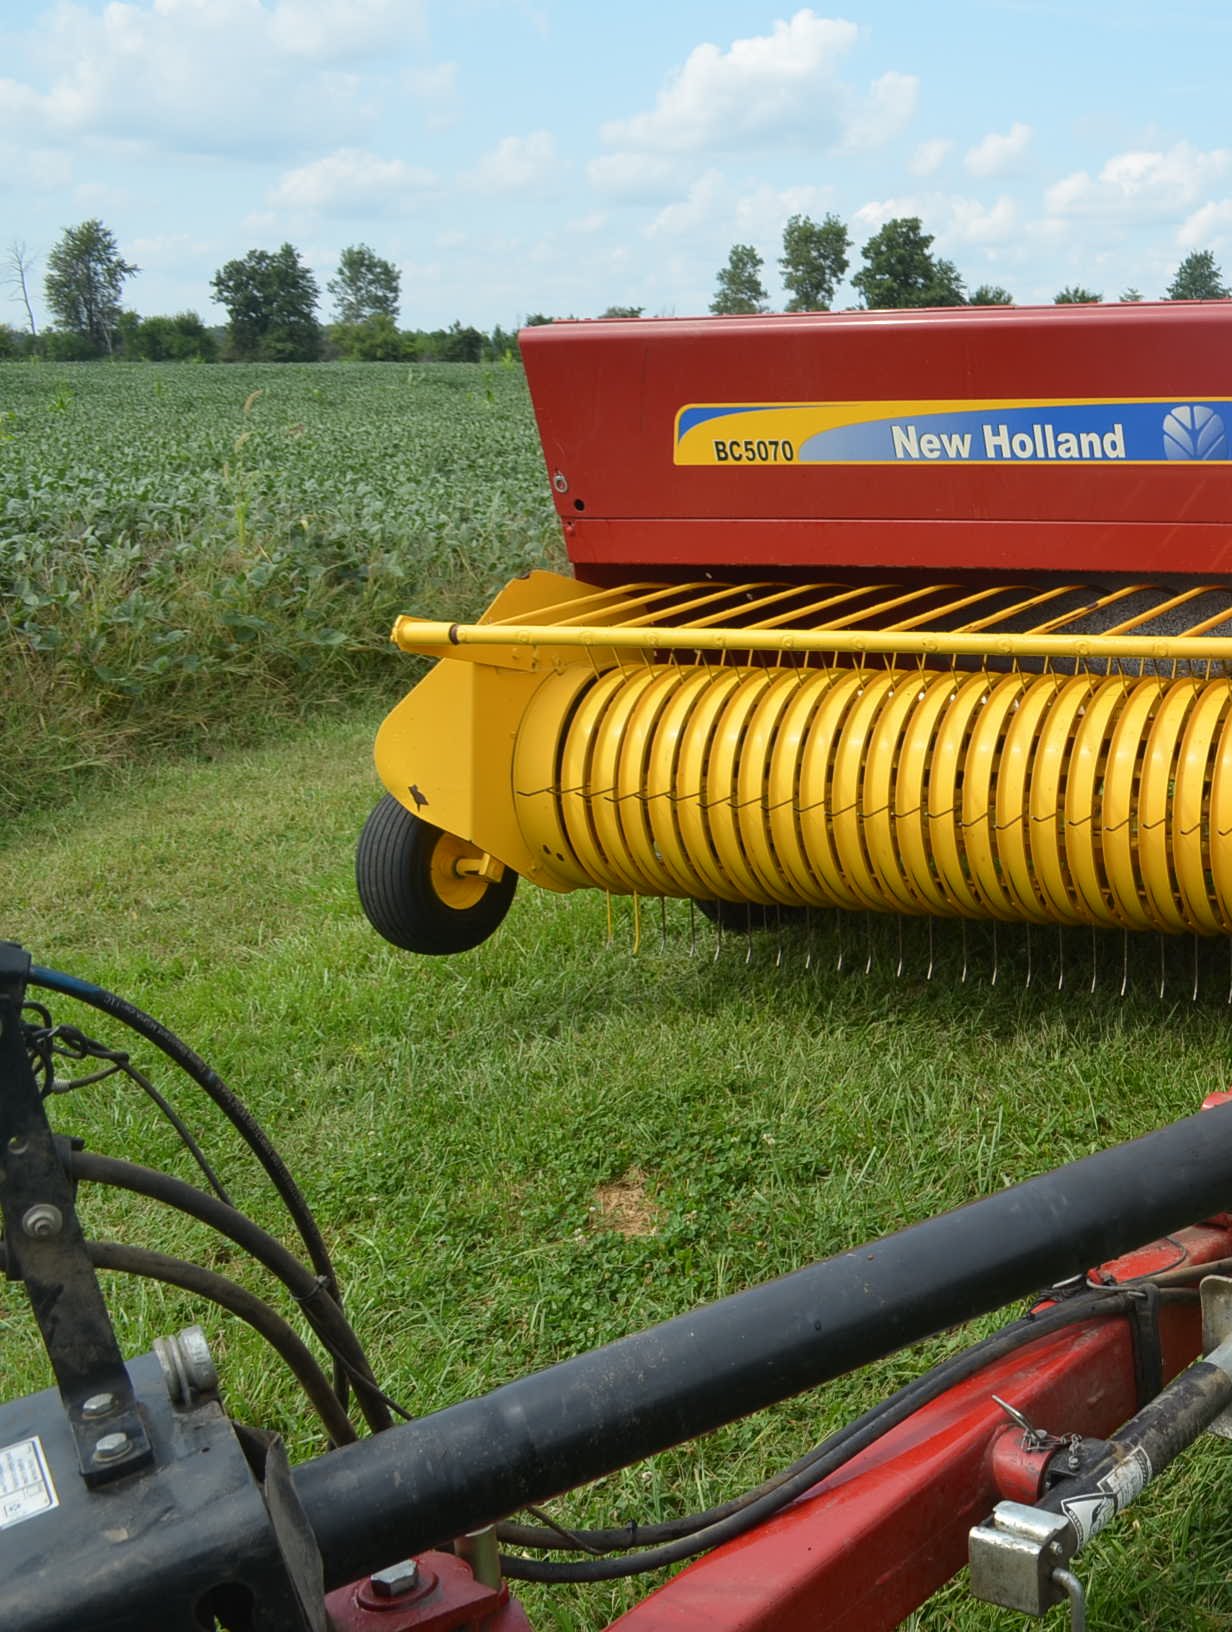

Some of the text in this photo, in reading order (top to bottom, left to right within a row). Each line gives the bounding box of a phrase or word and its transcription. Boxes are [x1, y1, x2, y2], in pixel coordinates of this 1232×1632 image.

[714, 439, 794, 462] BC5070
[891, 424, 1126, 459] New Holland
